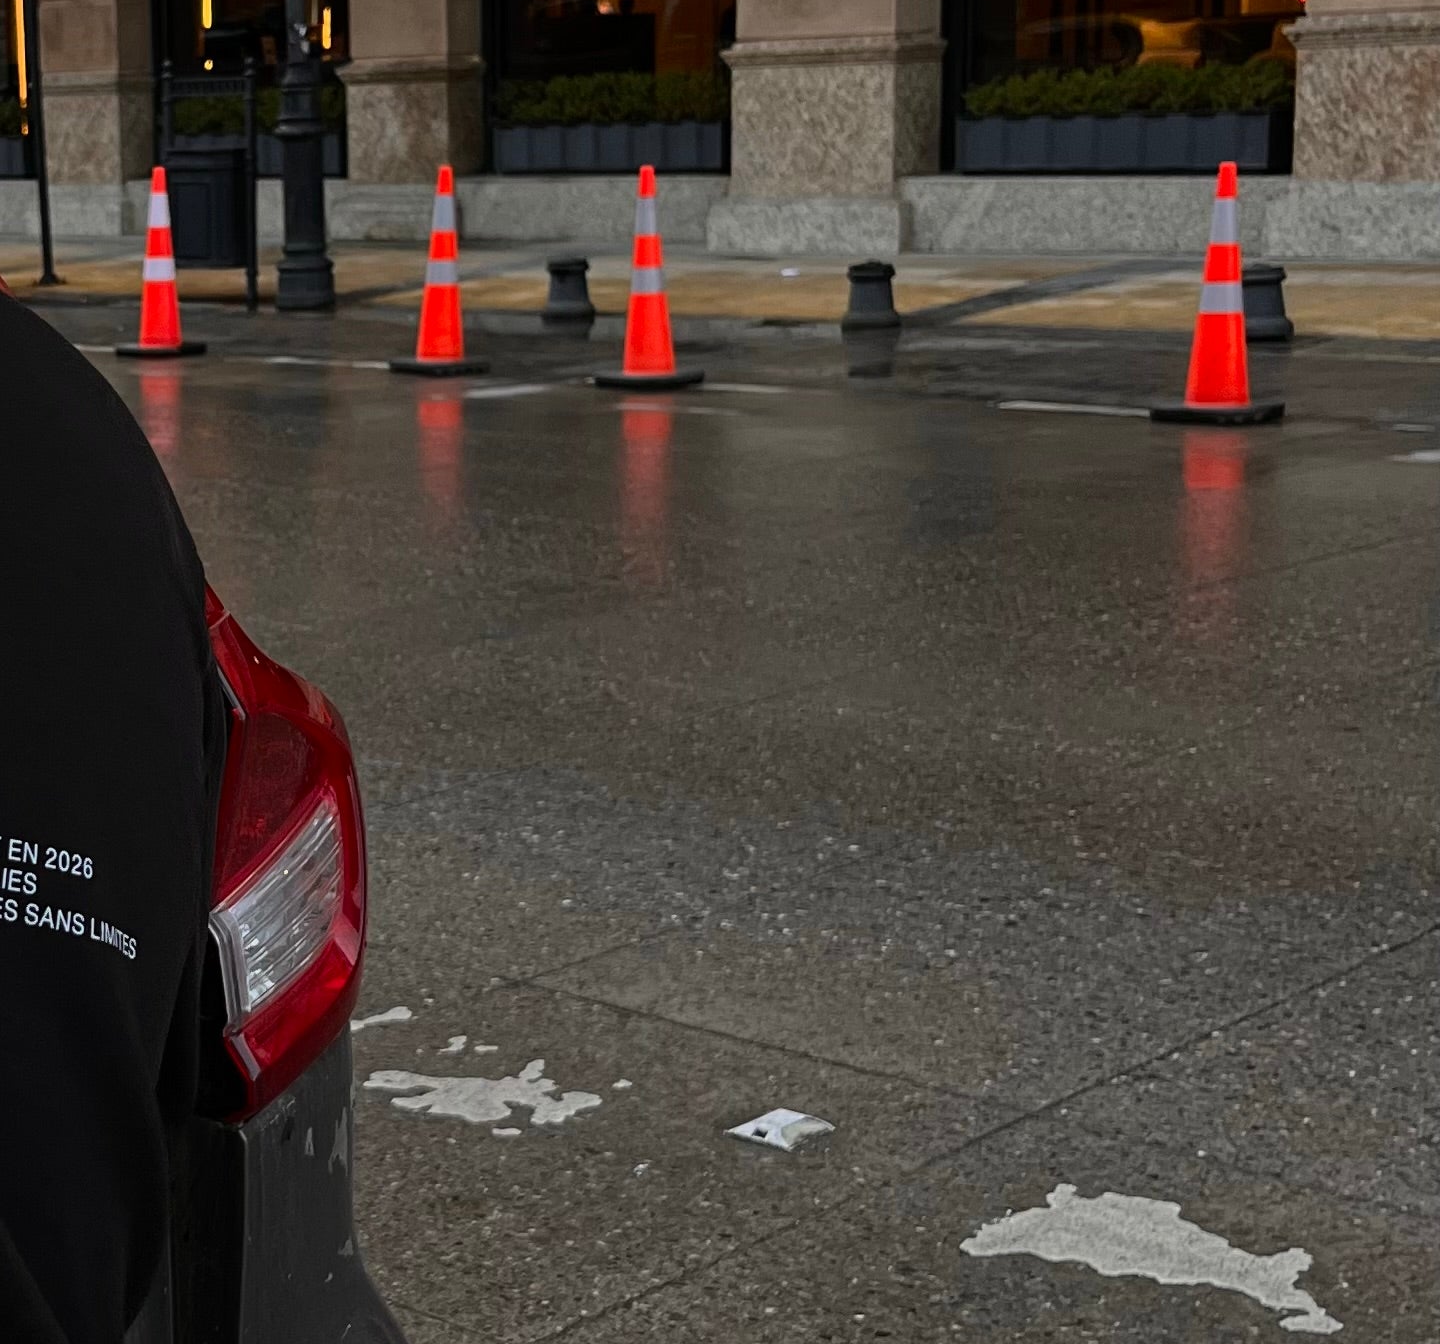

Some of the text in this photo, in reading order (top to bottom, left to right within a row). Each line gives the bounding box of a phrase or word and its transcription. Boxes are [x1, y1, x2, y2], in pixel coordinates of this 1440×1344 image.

[7, 838, 39, 865] EN
[44, 846, 94, 880] 2026
[23, 902, 85, 936] SANS
[90, 917, 137, 960] LIMITES
